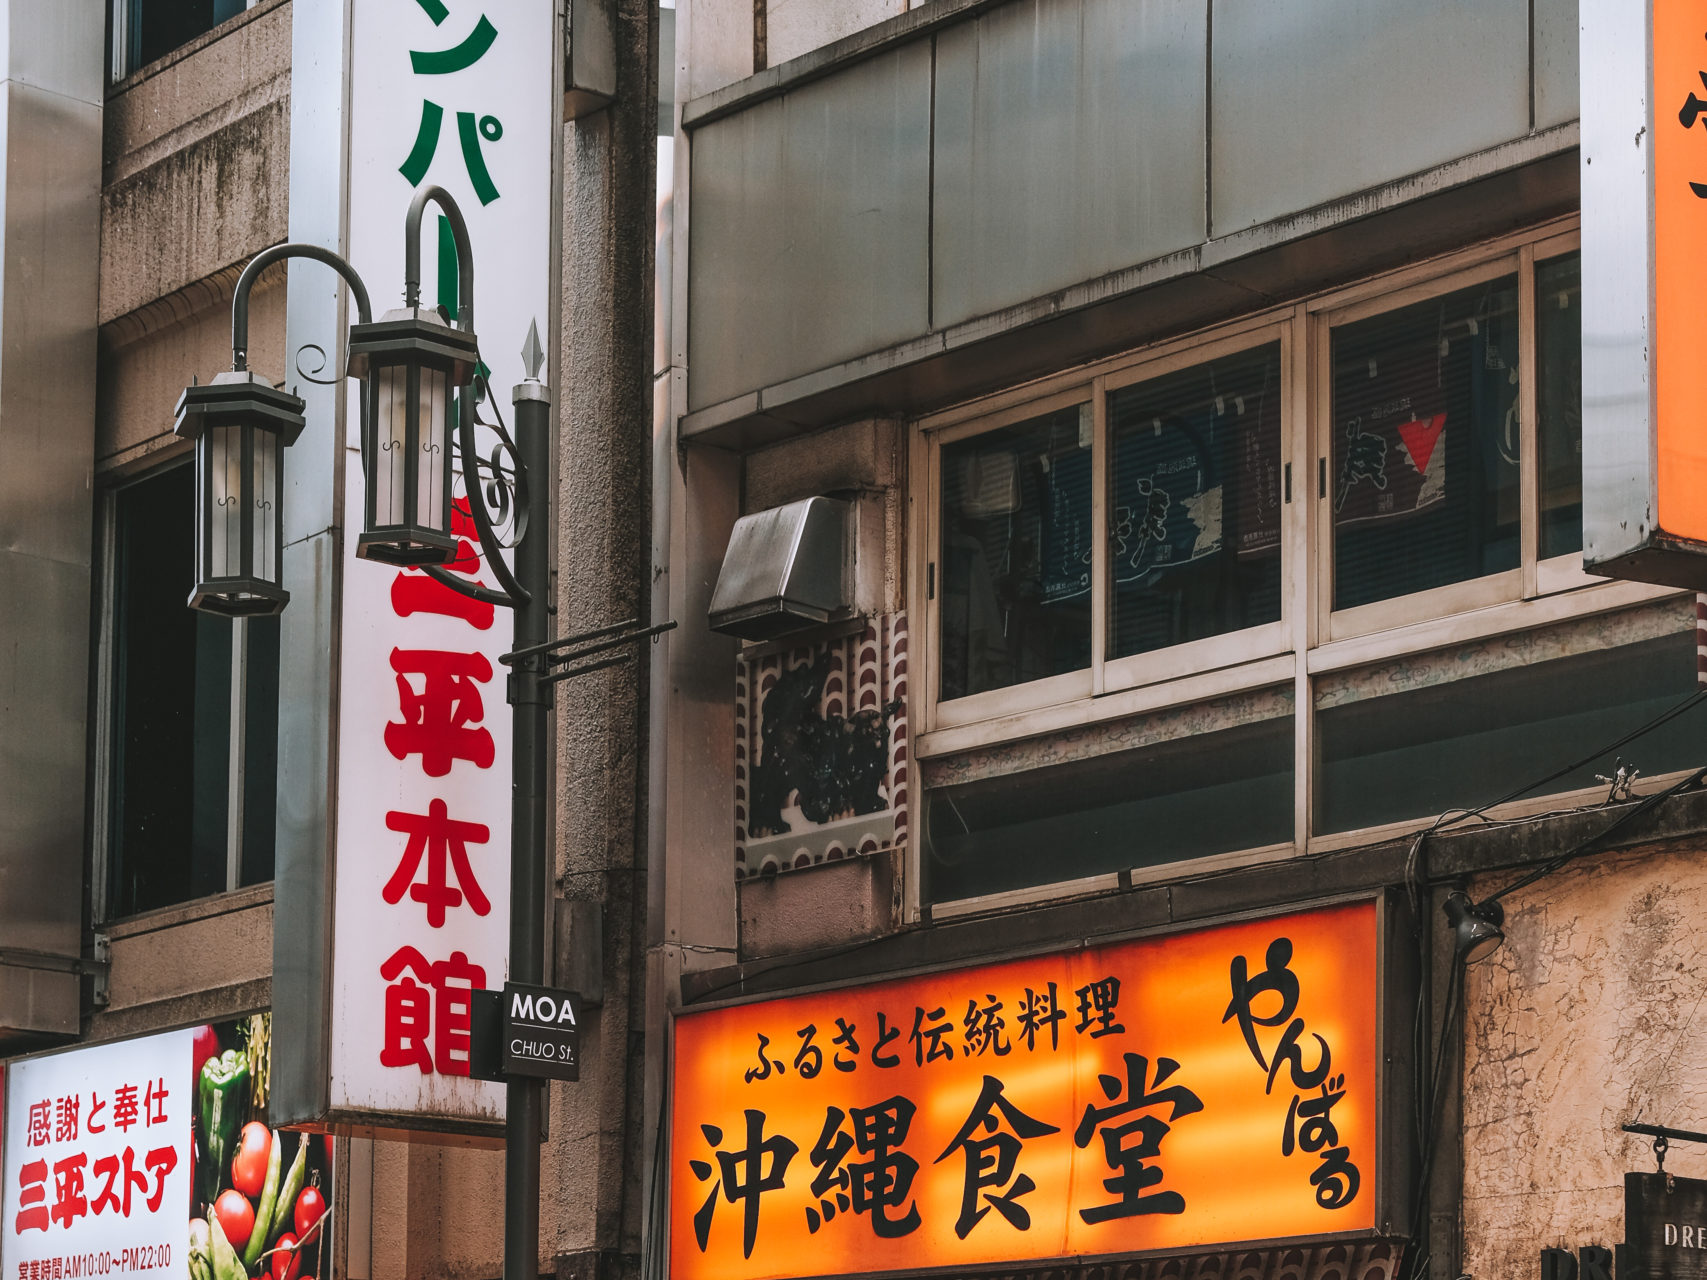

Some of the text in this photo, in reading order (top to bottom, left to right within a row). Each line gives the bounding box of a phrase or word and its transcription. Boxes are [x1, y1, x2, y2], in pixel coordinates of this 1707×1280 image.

[510, 1038, 574, 1063] CHUO St.
[511, 993, 576, 1026] MOA
[744, 975, 1126, 1085] ふるさと伝統料理
[27, 1077, 170, 1148] 感謝と奉仕
[1222, 937, 1360, 1210] やんばる
[16, 1145, 178, 1235] 三平ストア
[689, 1052, 1204, 1260] 沖縄食堂
